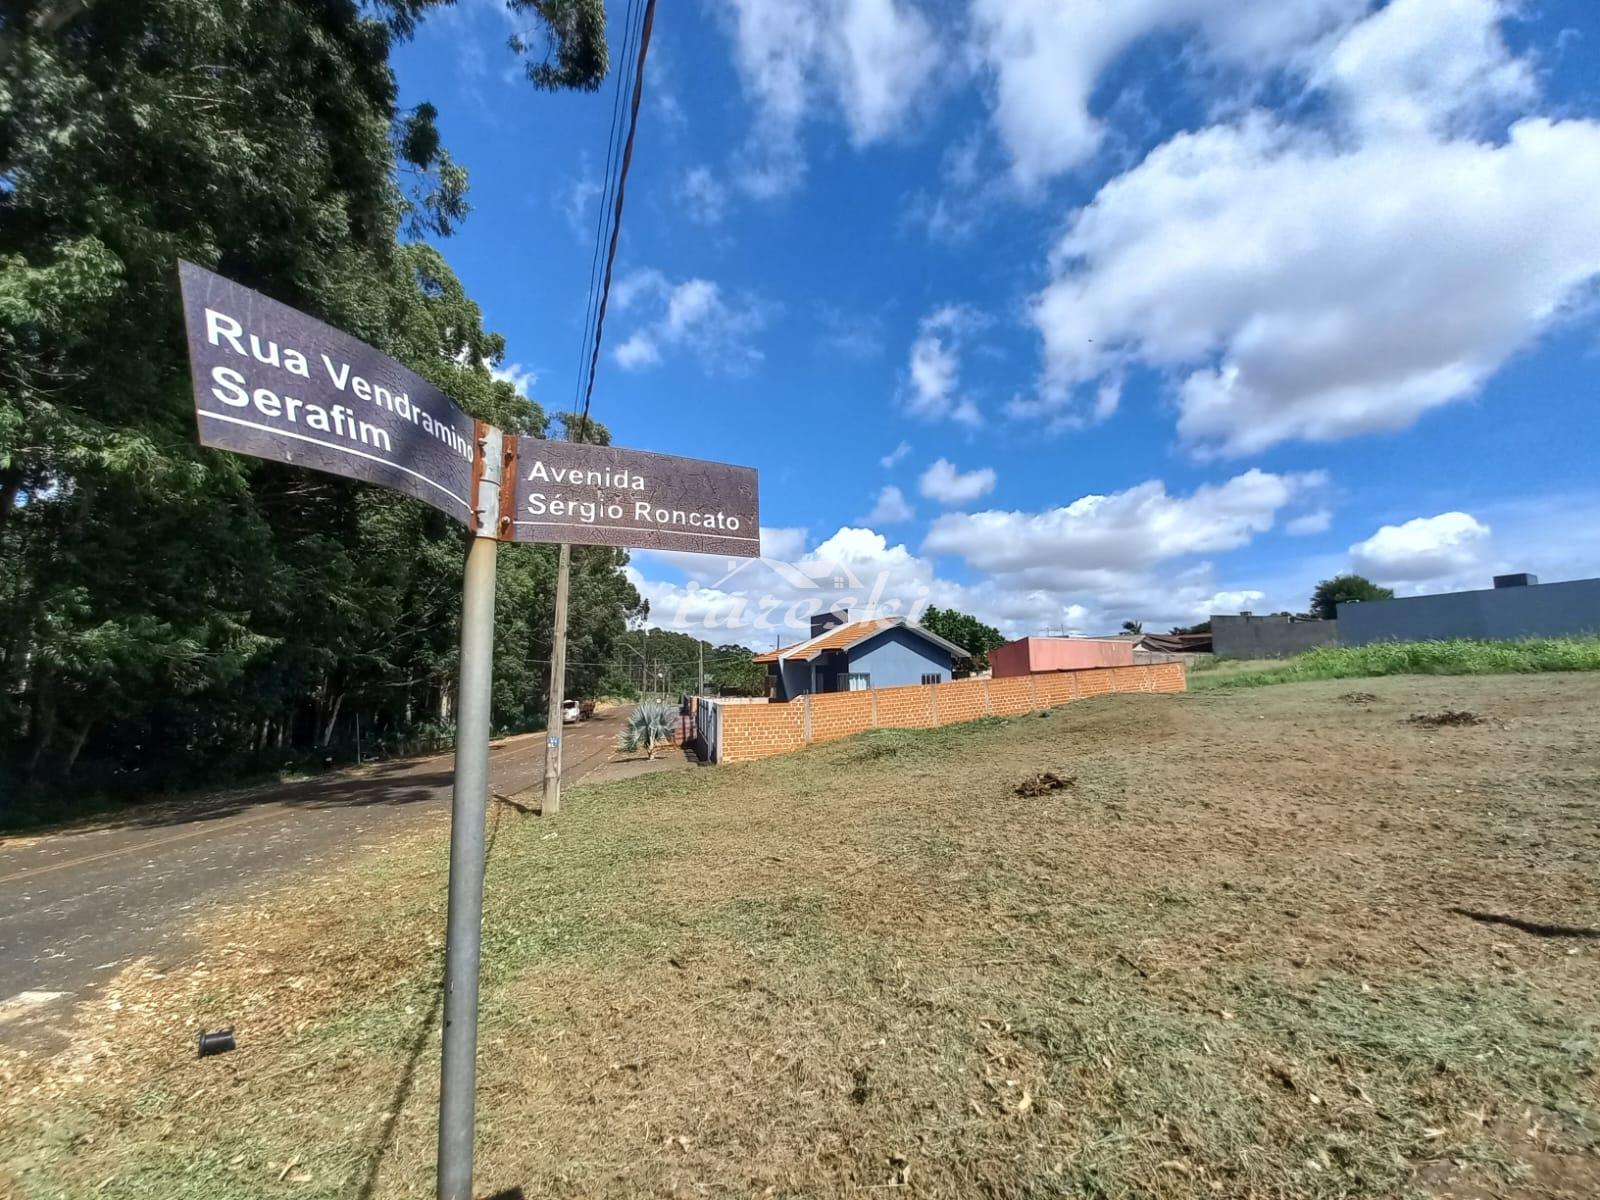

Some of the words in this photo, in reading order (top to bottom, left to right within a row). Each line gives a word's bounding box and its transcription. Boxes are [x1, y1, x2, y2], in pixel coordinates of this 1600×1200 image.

[205, 308, 310, 379] Rua
[320, 353, 474, 464] Vendramino
[211, 366, 391, 452] Serafim
[527, 460, 646, 491] Avenida
[527, 493, 623, 523] Sérgio
[634, 502, 741, 531] Roncato
